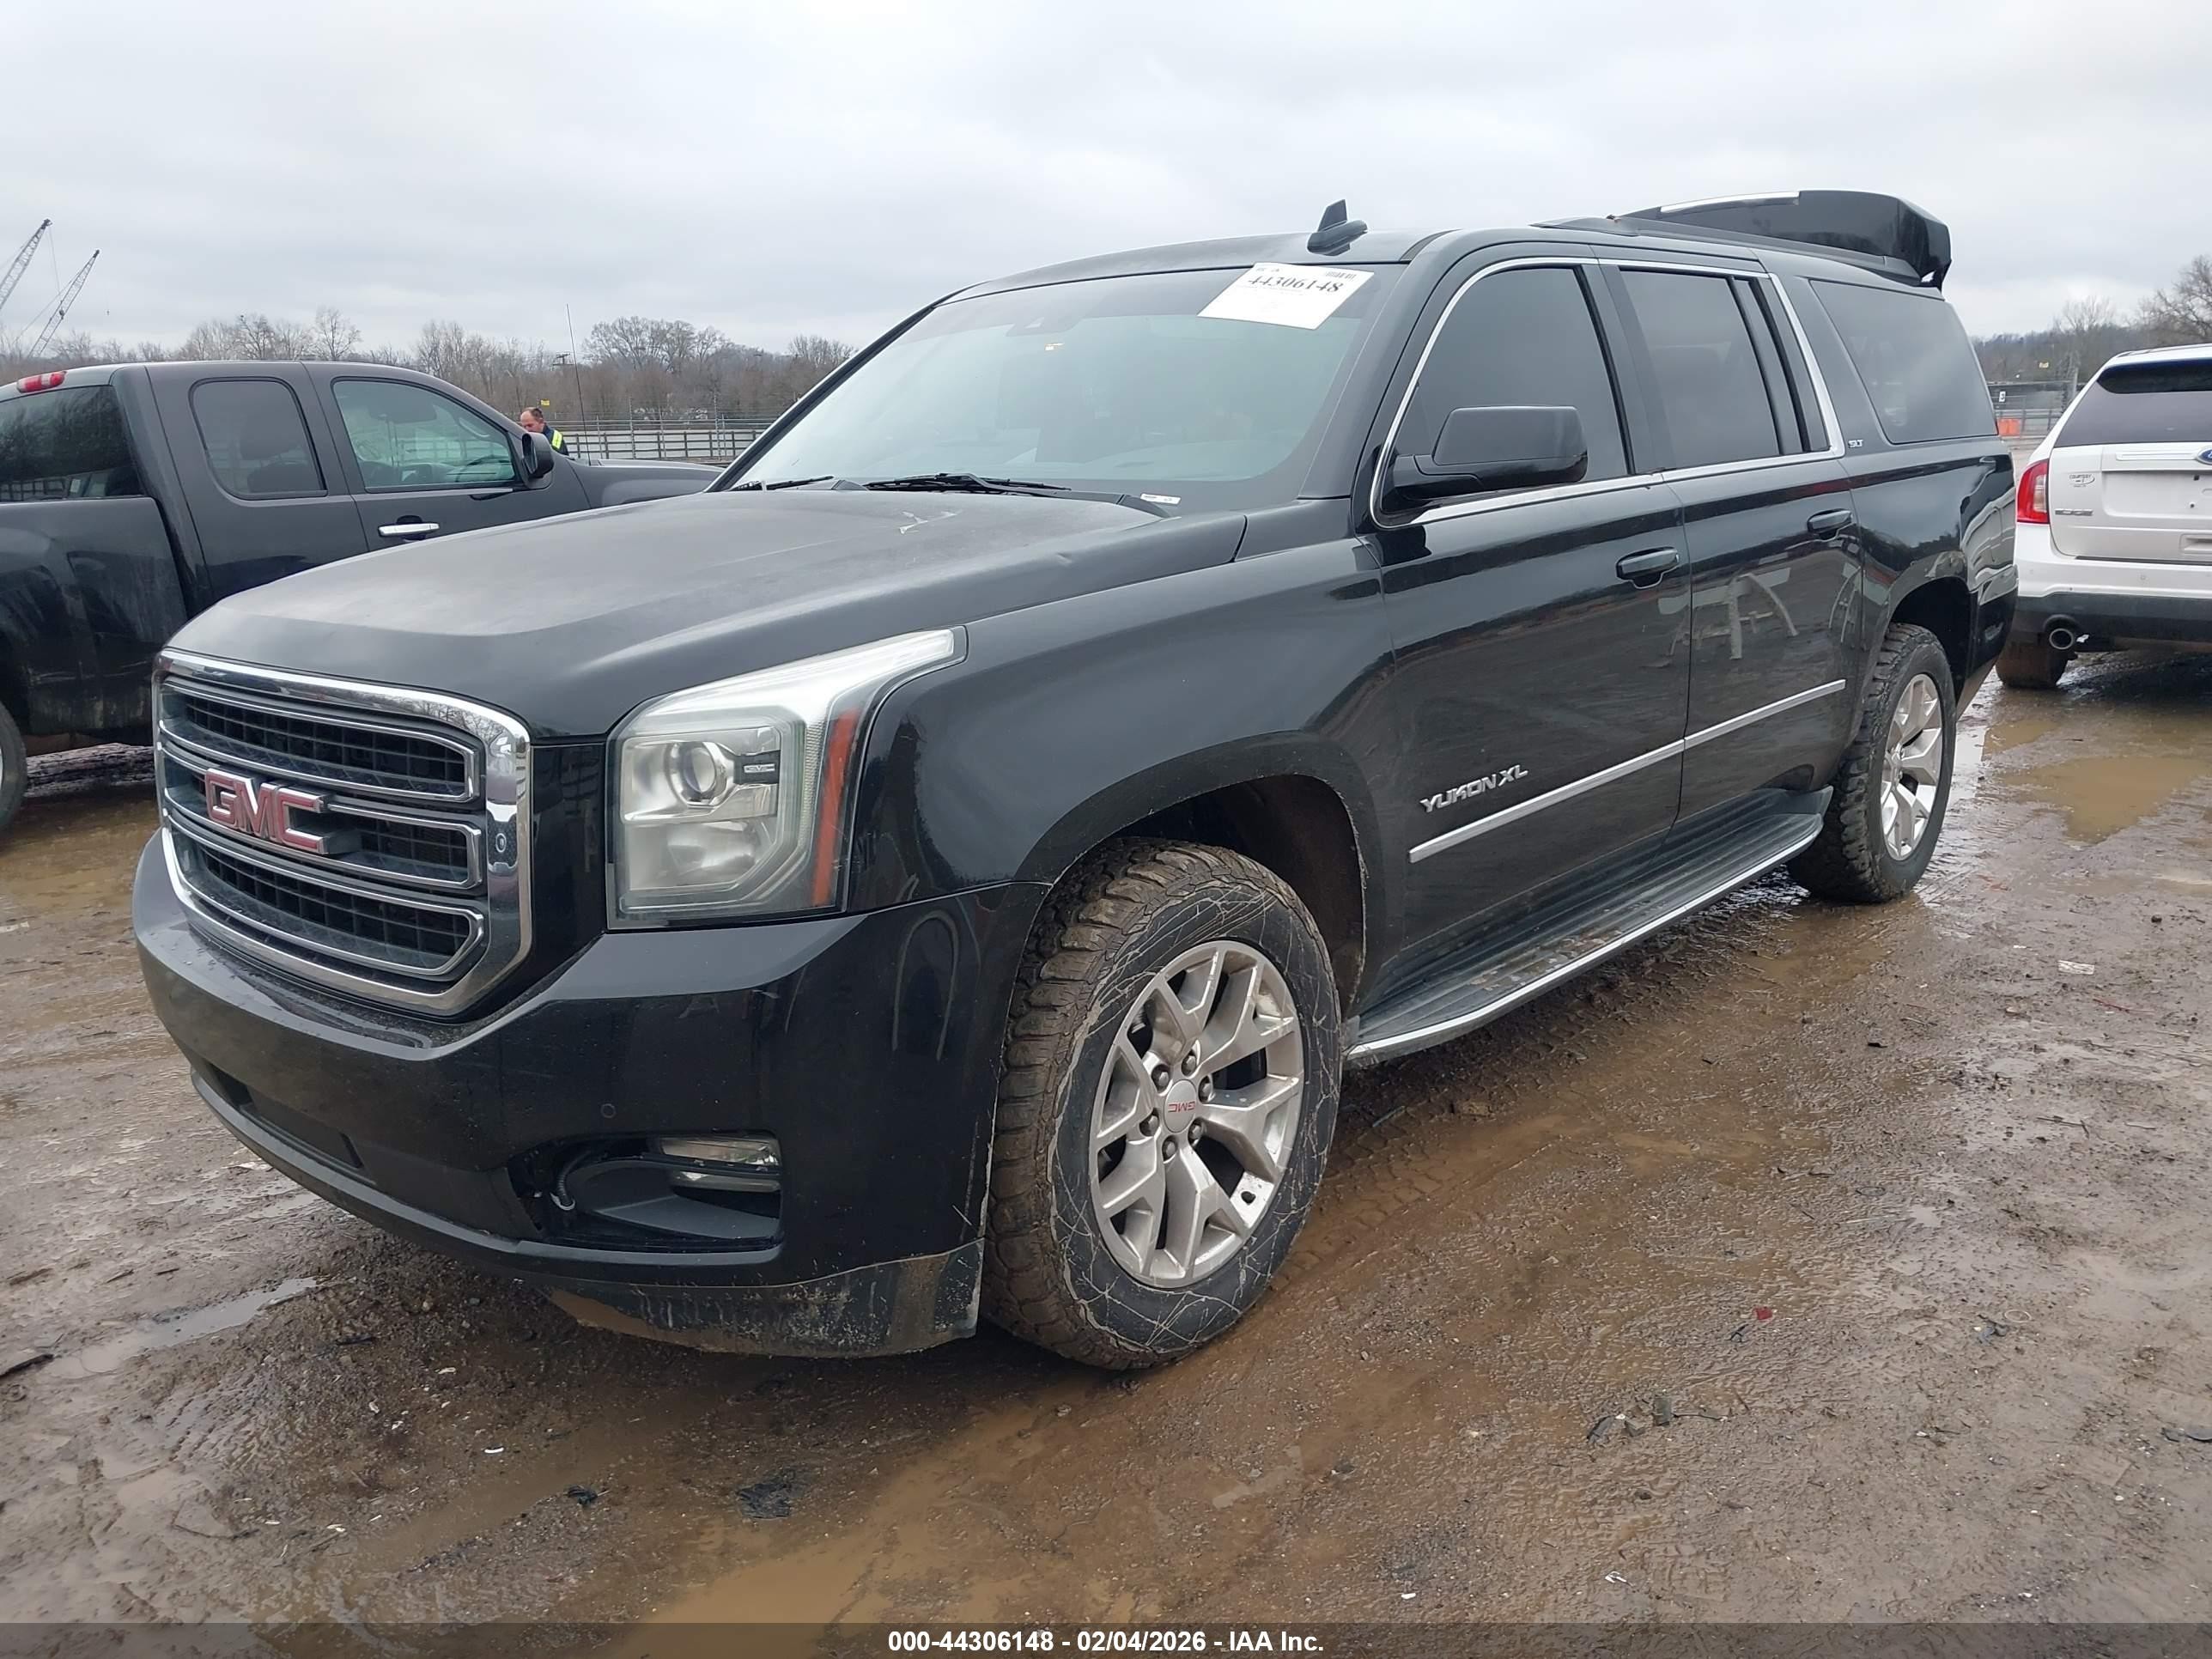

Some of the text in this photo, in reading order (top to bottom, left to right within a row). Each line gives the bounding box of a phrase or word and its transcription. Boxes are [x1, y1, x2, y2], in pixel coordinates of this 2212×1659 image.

[1248, 275, 1344, 293] 44306148
[1419, 764, 1528, 813] YUKON XL
[205, 769, 329, 854] GMC
[1168, 1101, 1196, 1113] GMC
